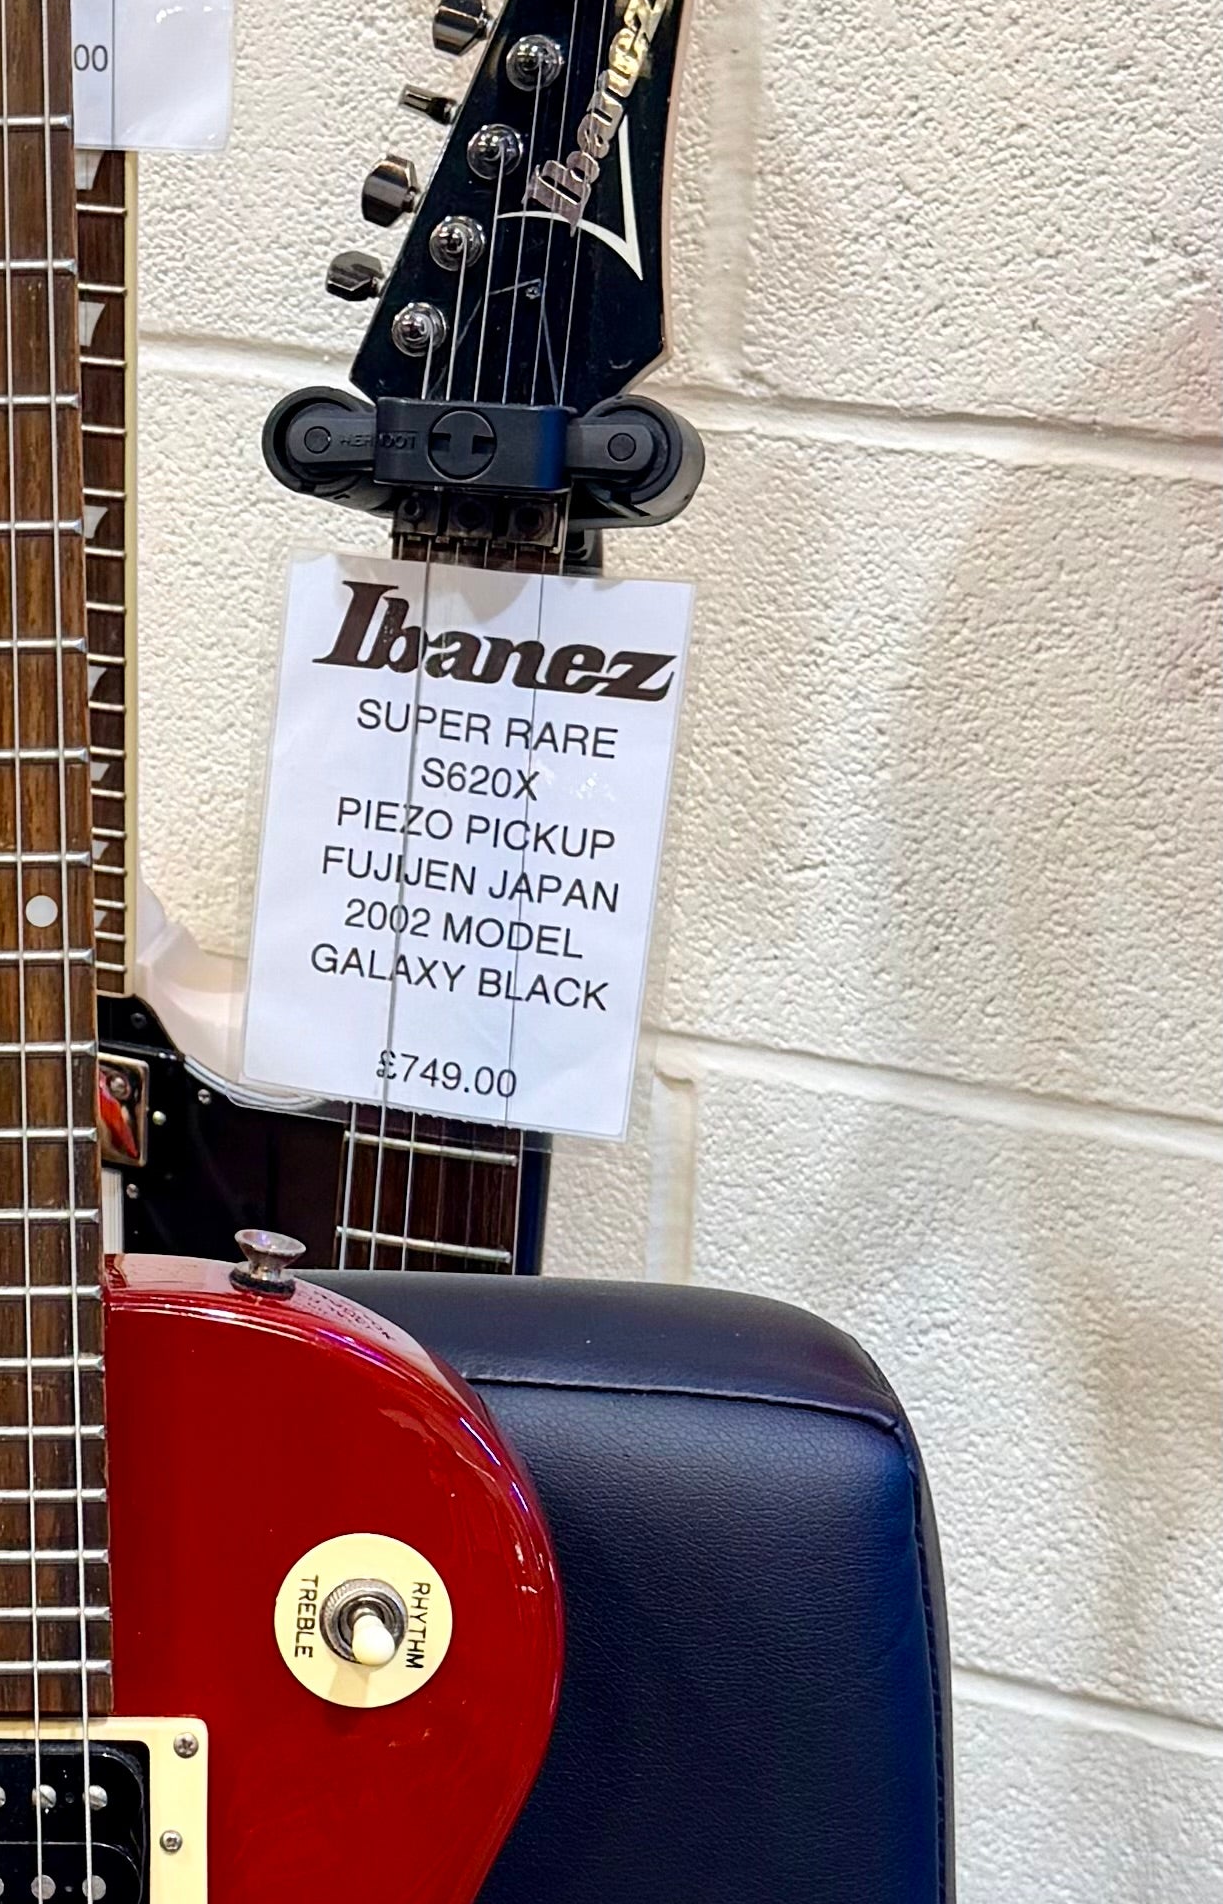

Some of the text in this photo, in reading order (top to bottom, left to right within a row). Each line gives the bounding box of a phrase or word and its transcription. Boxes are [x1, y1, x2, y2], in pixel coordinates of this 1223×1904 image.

[312, 579, 678, 702] Ibanez
[356, 698, 619, 759] SUPER RARE
[420, 757, 542, 802] S620X
[336, 796, 616, 861] PIEZO PICKUP
[321, 845, 620, 913] FUJIJEN JAPAN
[343, 897, 584, 959] 2002 MODEL
[310, 942, 610, 1012] GALAXY BLACK
[375, 1048, 518, 1098] £749.00
[294, 1574, 320, 1659] TREBLE
[405, 1581, 432, 1670] RHYTHM
